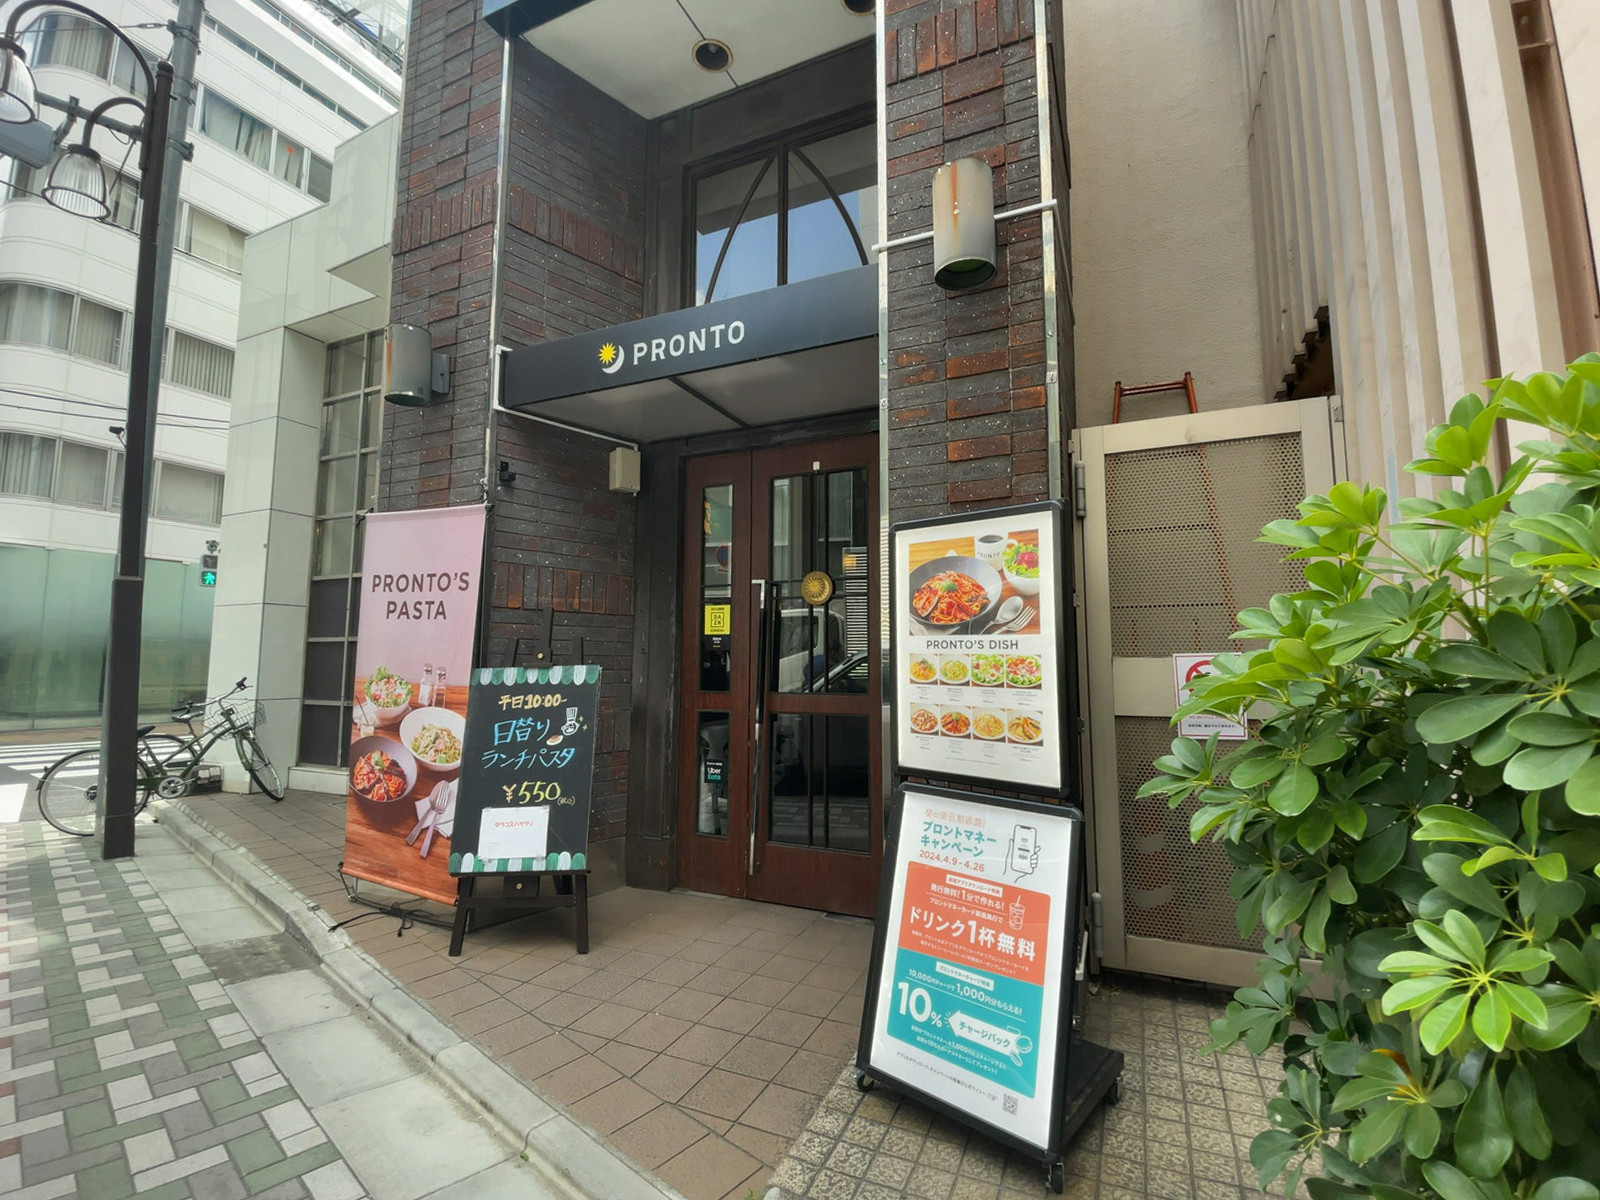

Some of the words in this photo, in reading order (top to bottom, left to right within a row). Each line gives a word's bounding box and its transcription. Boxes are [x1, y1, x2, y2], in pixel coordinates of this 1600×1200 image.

[633, 320, 745, 365] PRONTO
[372, 572, 470, 593] PRONTO'S
[386, 600, 447, 620] PASTA
[926, 640, 985, 650] PRONTO'S
[989, 640, 1019, 650] DISH
[493, 716, 550, 746] 日替り
[481, 747, 576, 770] ランチパスタ
[920, 834, 984, 857] キャンペーン
[909, 905, 1036, 962] ドリンク1杯無料
[898, 981, 943, 1028] 10%
